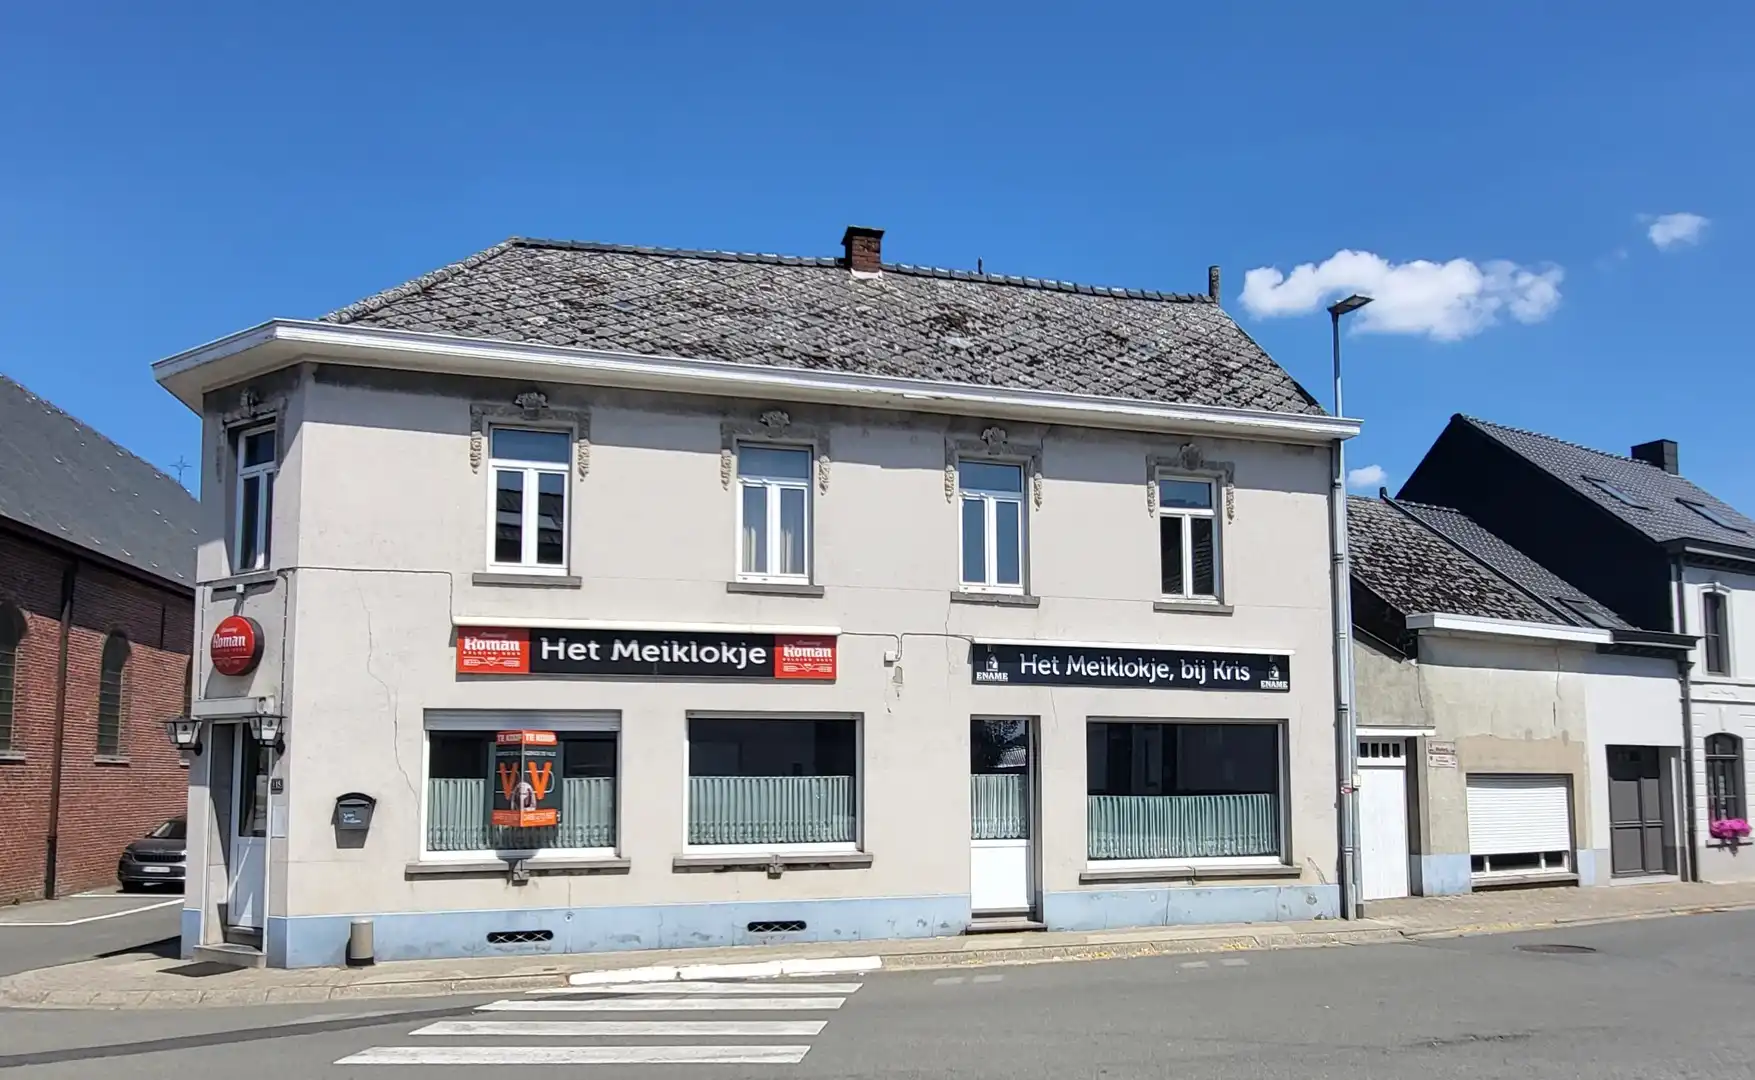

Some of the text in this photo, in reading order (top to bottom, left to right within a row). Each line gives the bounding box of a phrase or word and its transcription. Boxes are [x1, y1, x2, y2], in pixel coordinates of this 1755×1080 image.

[212, 633, 246, 649] Roman
[464, 636, 521, 651] Roman
[540, 637, 767, 669] Het Meiklokje
[783, 643, 833, 658] Roman
[976, 671, 1009, 681] ENAME
[1020, 653, 1251, 684] Het Meiklokje, bij Kris
[1260, 679, 1288, 689] ENAME
